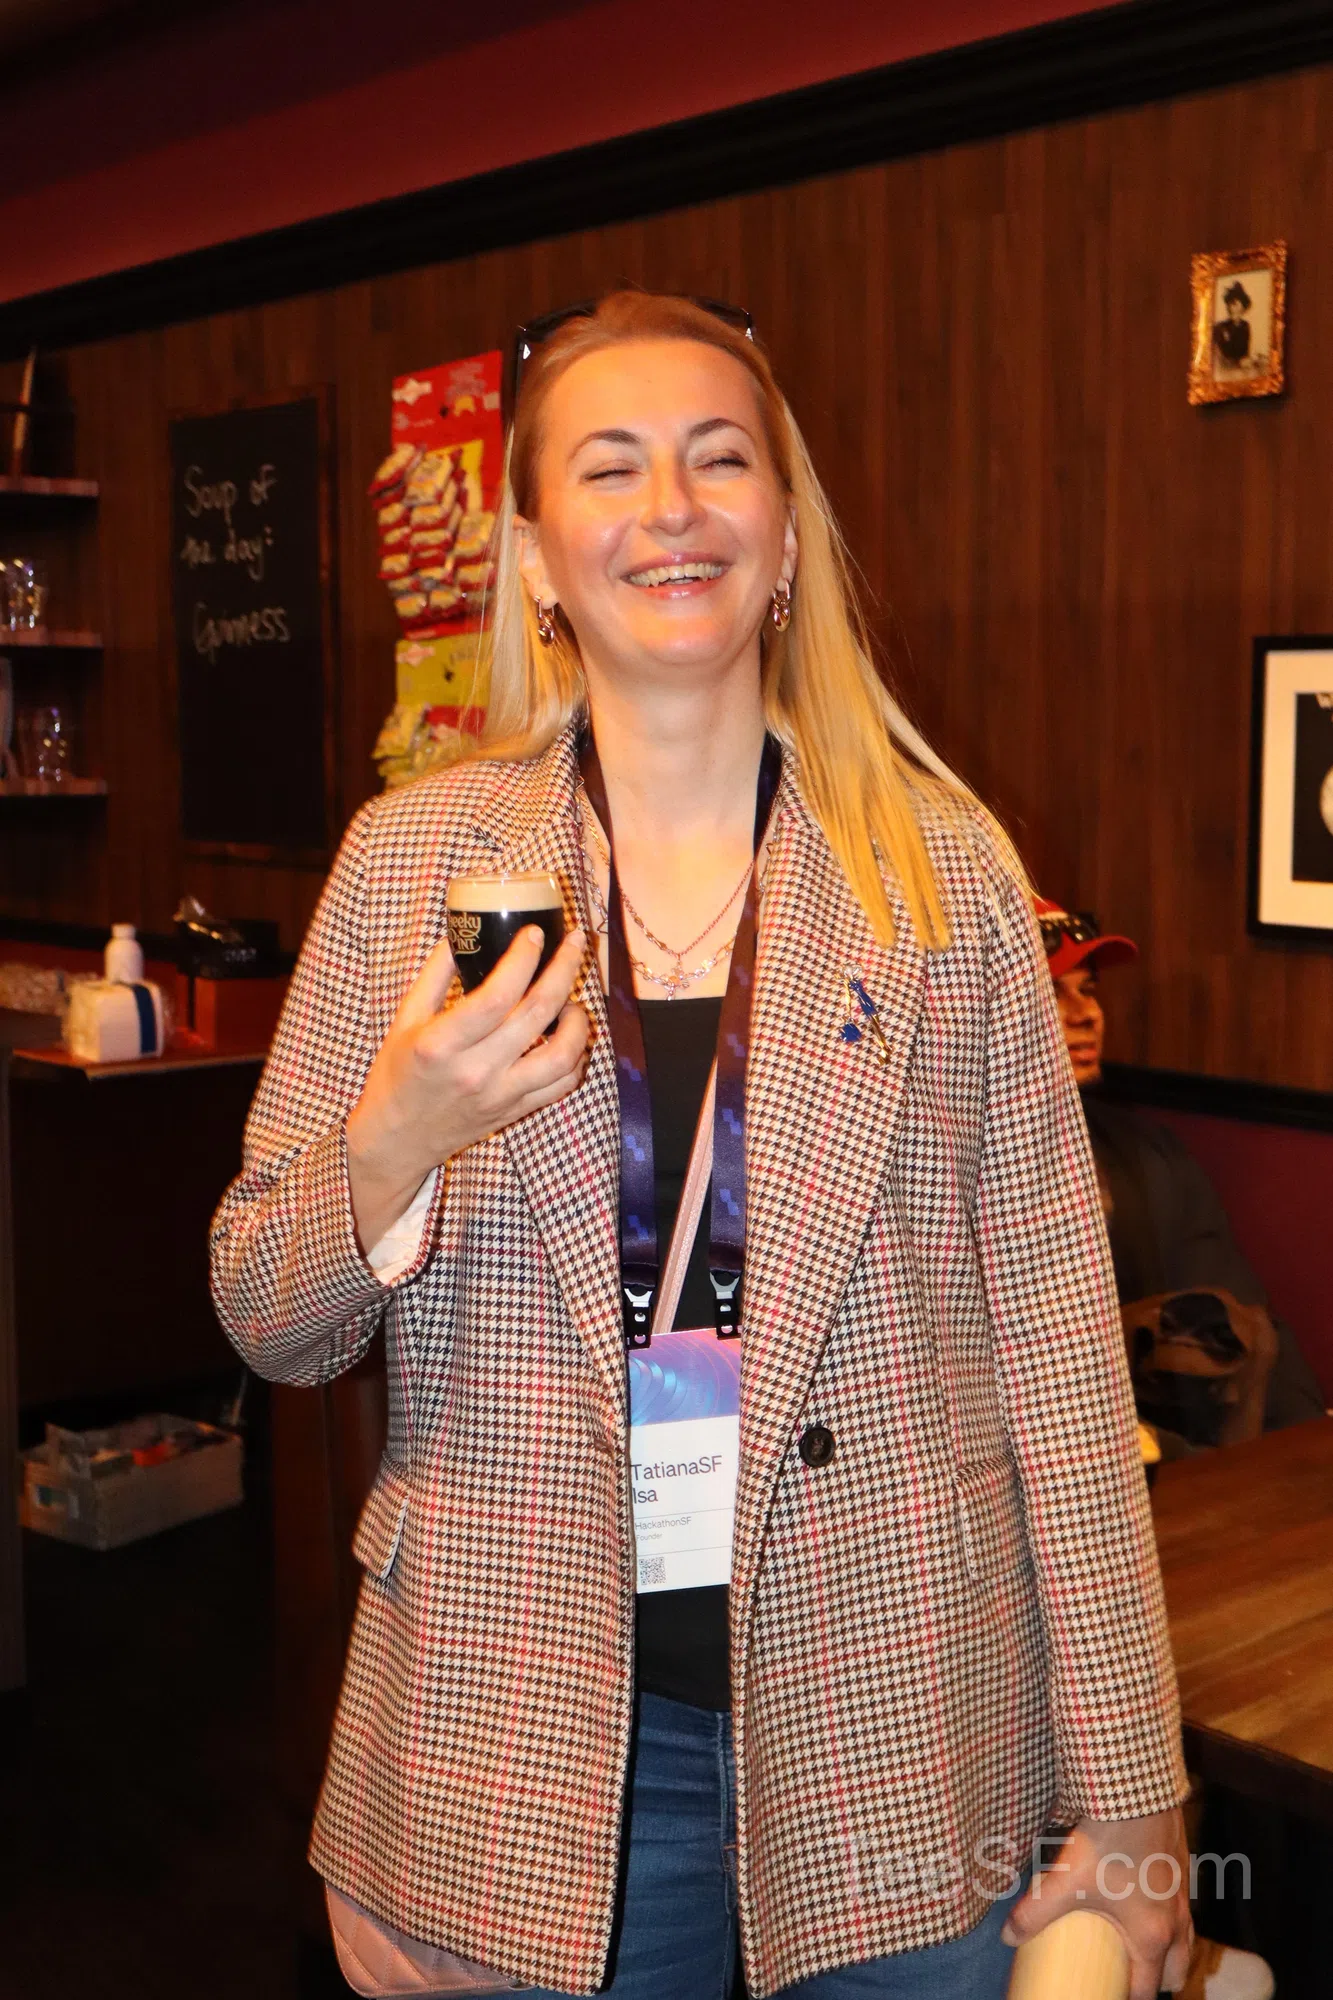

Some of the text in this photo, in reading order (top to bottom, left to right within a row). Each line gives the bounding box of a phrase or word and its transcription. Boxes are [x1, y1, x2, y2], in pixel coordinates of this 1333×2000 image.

[184, 464, 278, 526] Soup of
[447, 911, 481, 936] heeky
[630, 1455, 722, 1481] TatianaSF
[634, 1516, 692, 1530] HackathonSF
[636, 1533, 663, 1541] Founder
